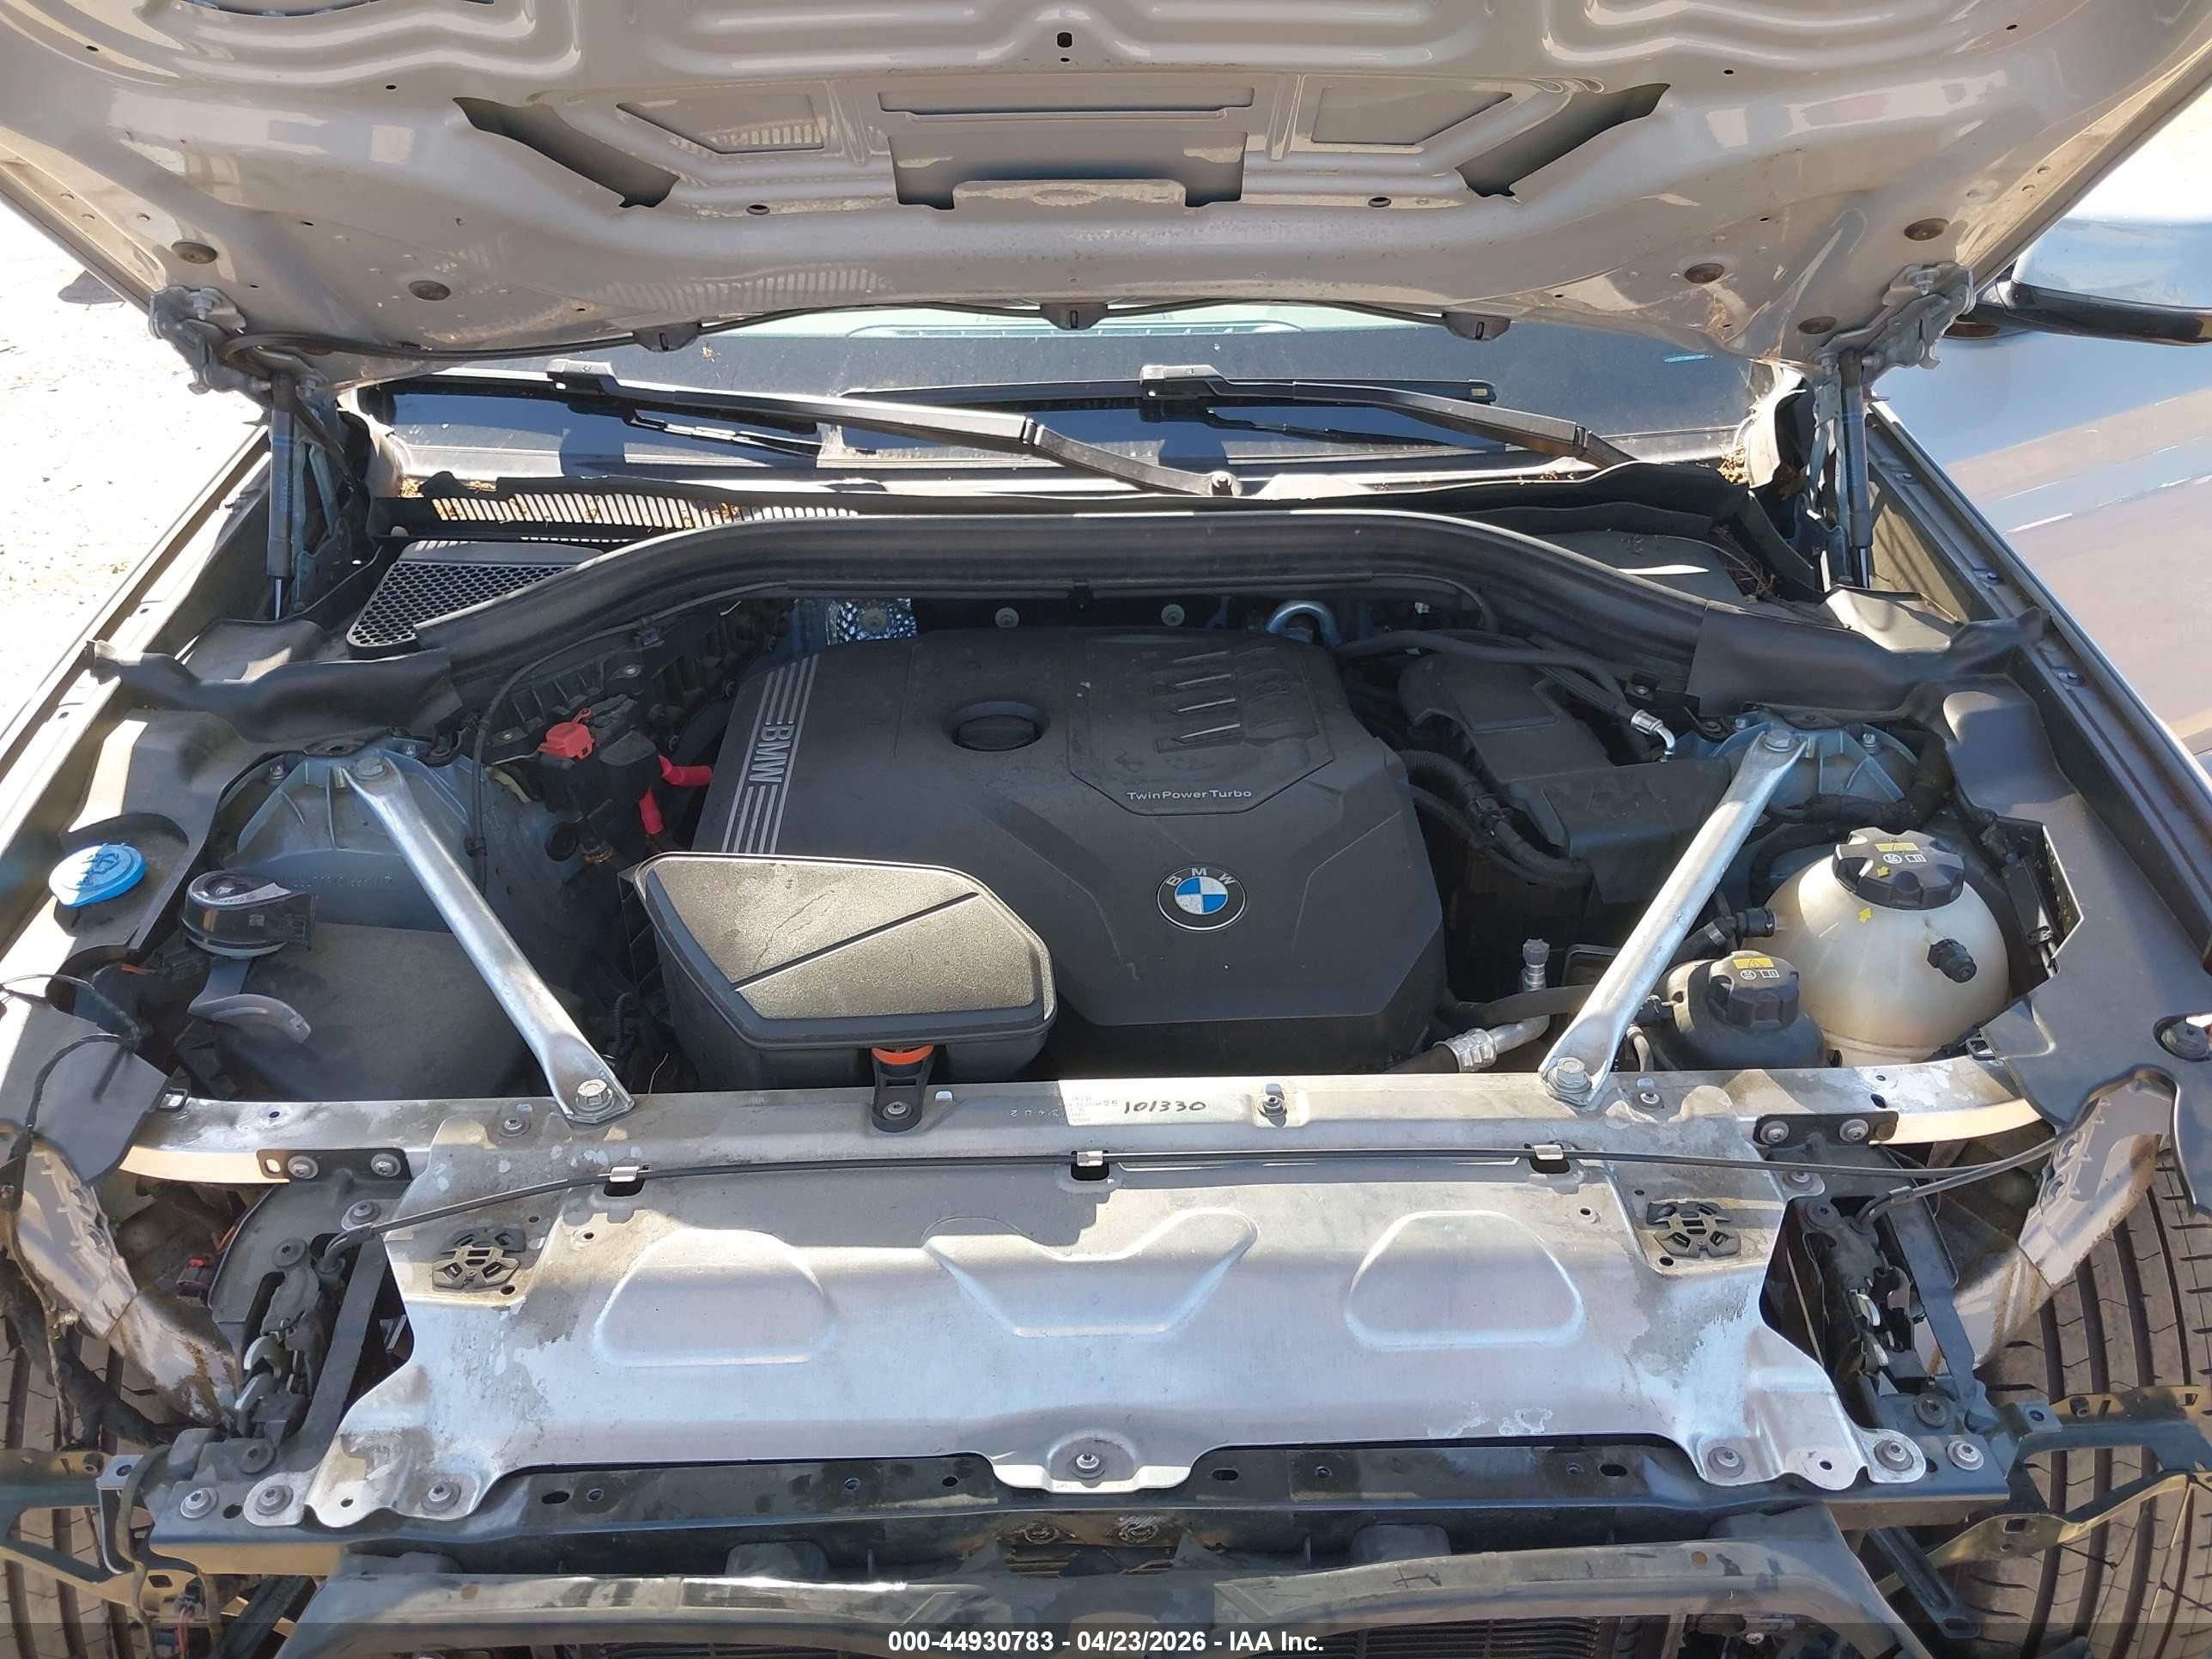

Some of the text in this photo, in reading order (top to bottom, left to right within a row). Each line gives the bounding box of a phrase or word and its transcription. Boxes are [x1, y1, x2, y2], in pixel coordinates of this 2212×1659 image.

[749, 725, 794, 782] BMW
[1166, 867, 1237, 886] BMW
[1124, 1101, 1206, 1114] 101330
